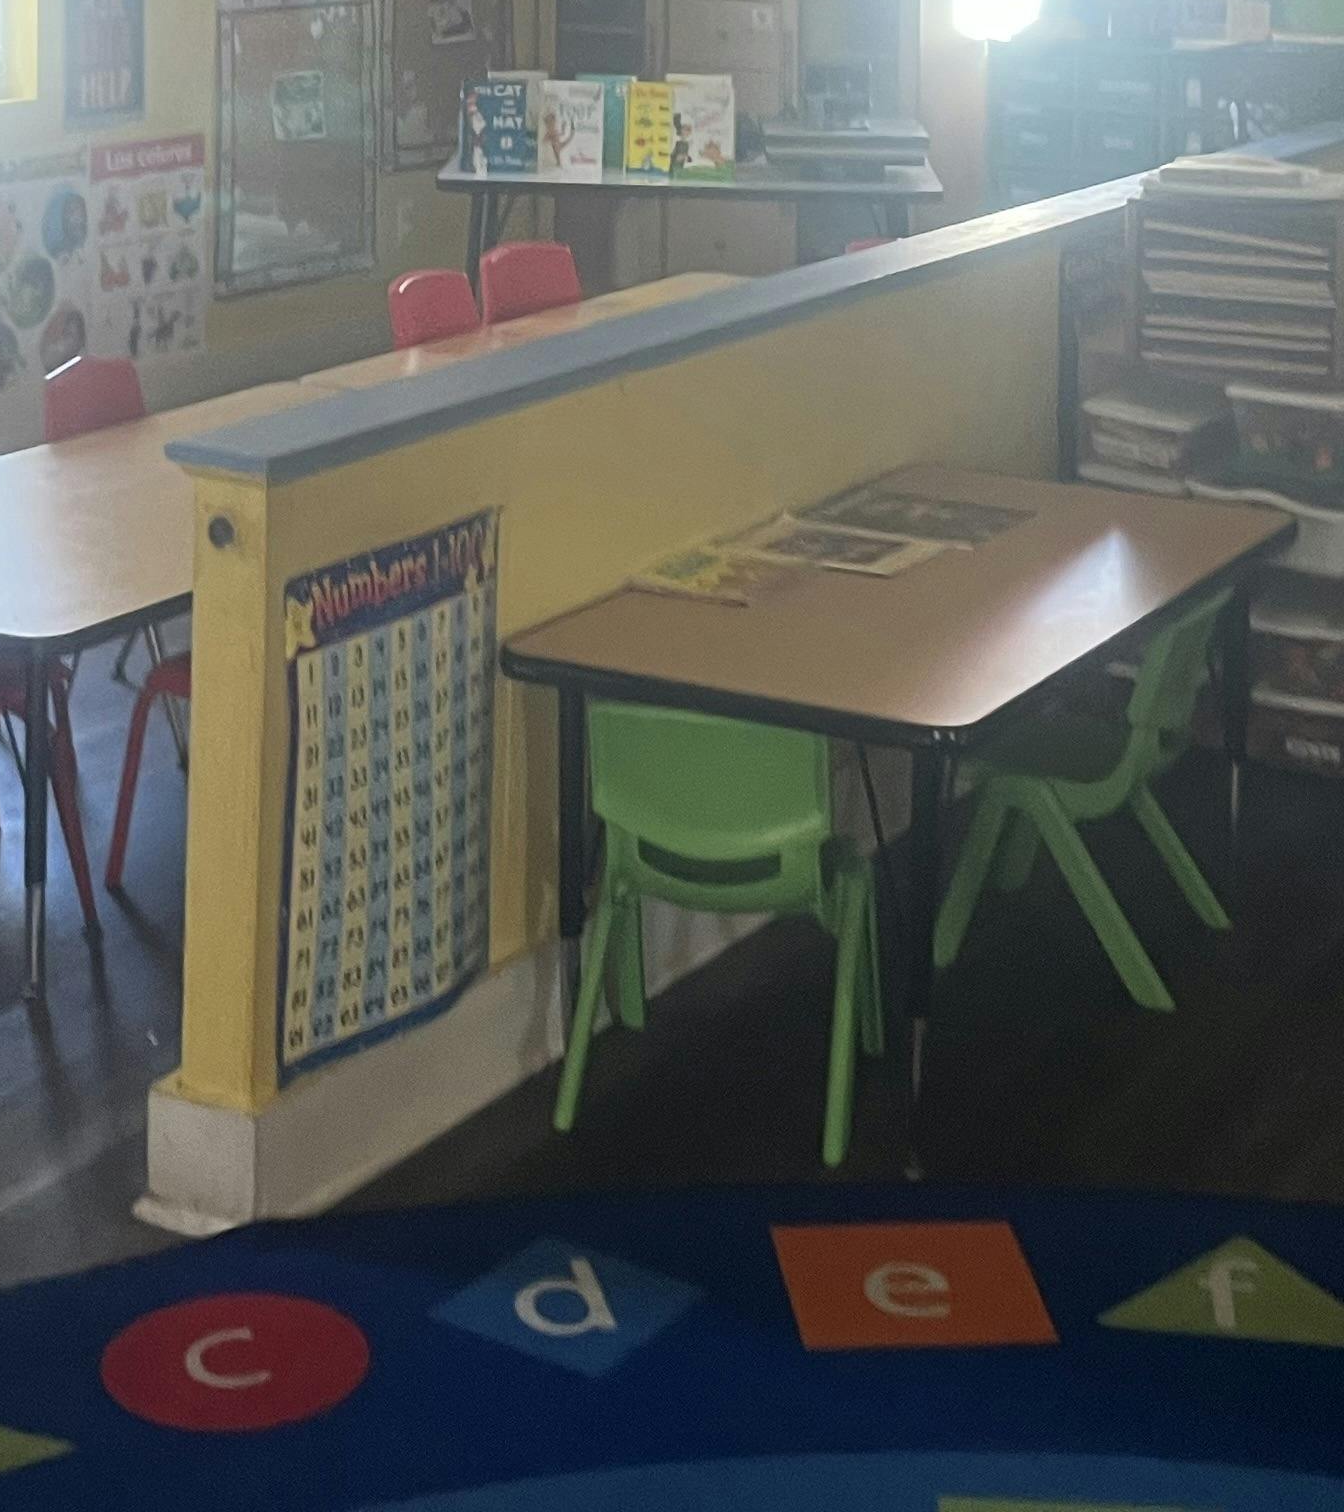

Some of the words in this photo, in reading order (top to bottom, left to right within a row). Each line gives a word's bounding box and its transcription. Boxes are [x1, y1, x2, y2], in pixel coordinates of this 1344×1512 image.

[494, 85, 523, 97] CAT
[493, 116, 523, 130] HAT
[105, 150, 133, 171] Los
[137, 144, 193, 167] colores
[311, 551, 427, 631] Numbers
[512, 1257, 619, 1337] d
[862, 1261, 952, 1319] e
[1198, 1255, 1259, 1329] f
[183, 1328, 272, 1389] c
